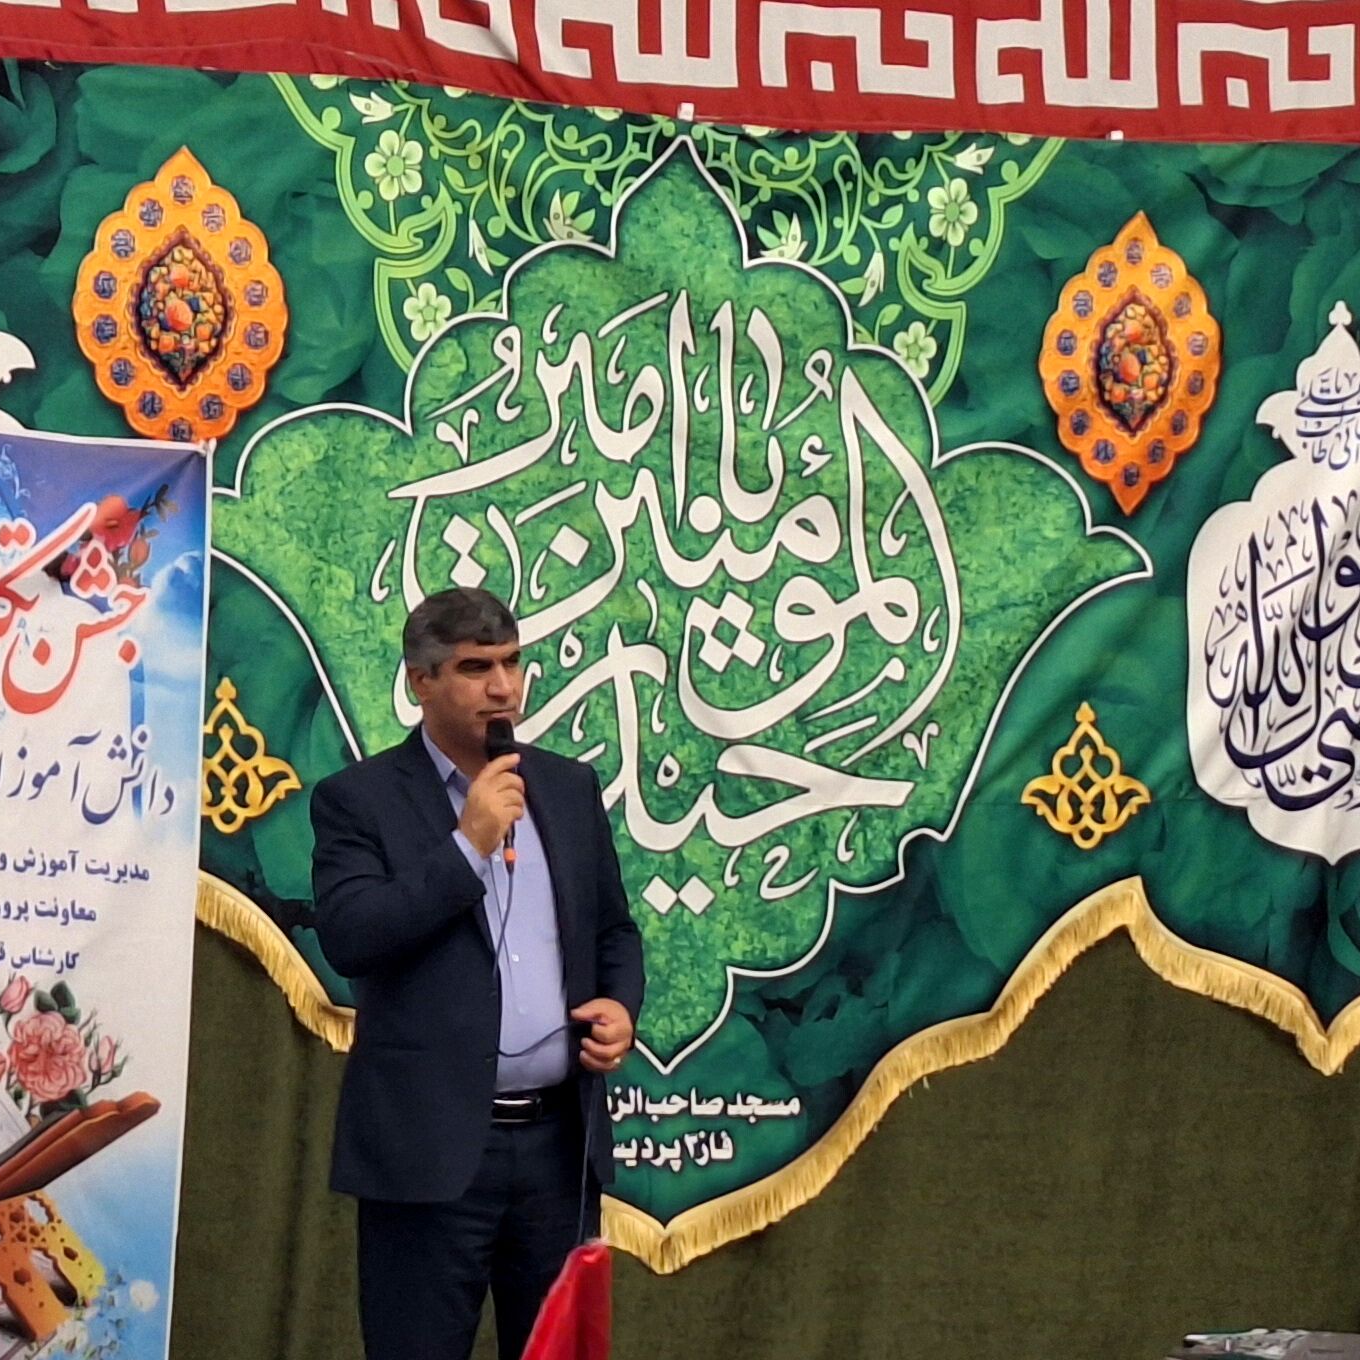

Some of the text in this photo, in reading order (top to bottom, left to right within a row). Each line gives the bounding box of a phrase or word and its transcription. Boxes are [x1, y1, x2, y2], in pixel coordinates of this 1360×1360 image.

[0, 544, 147, 715] جشن
[82, 730, 176, 825] دانش
[13, 849, 79, 877] آموزش
[85, 856, 150, 885] مدیریت
[33, 897, 97, 926] معاونت
[9, 944, 80, 975] کارشناس
[644, 1087, 724, 1122] صاحب
[726, 1090, 801, 1124] مسجد
